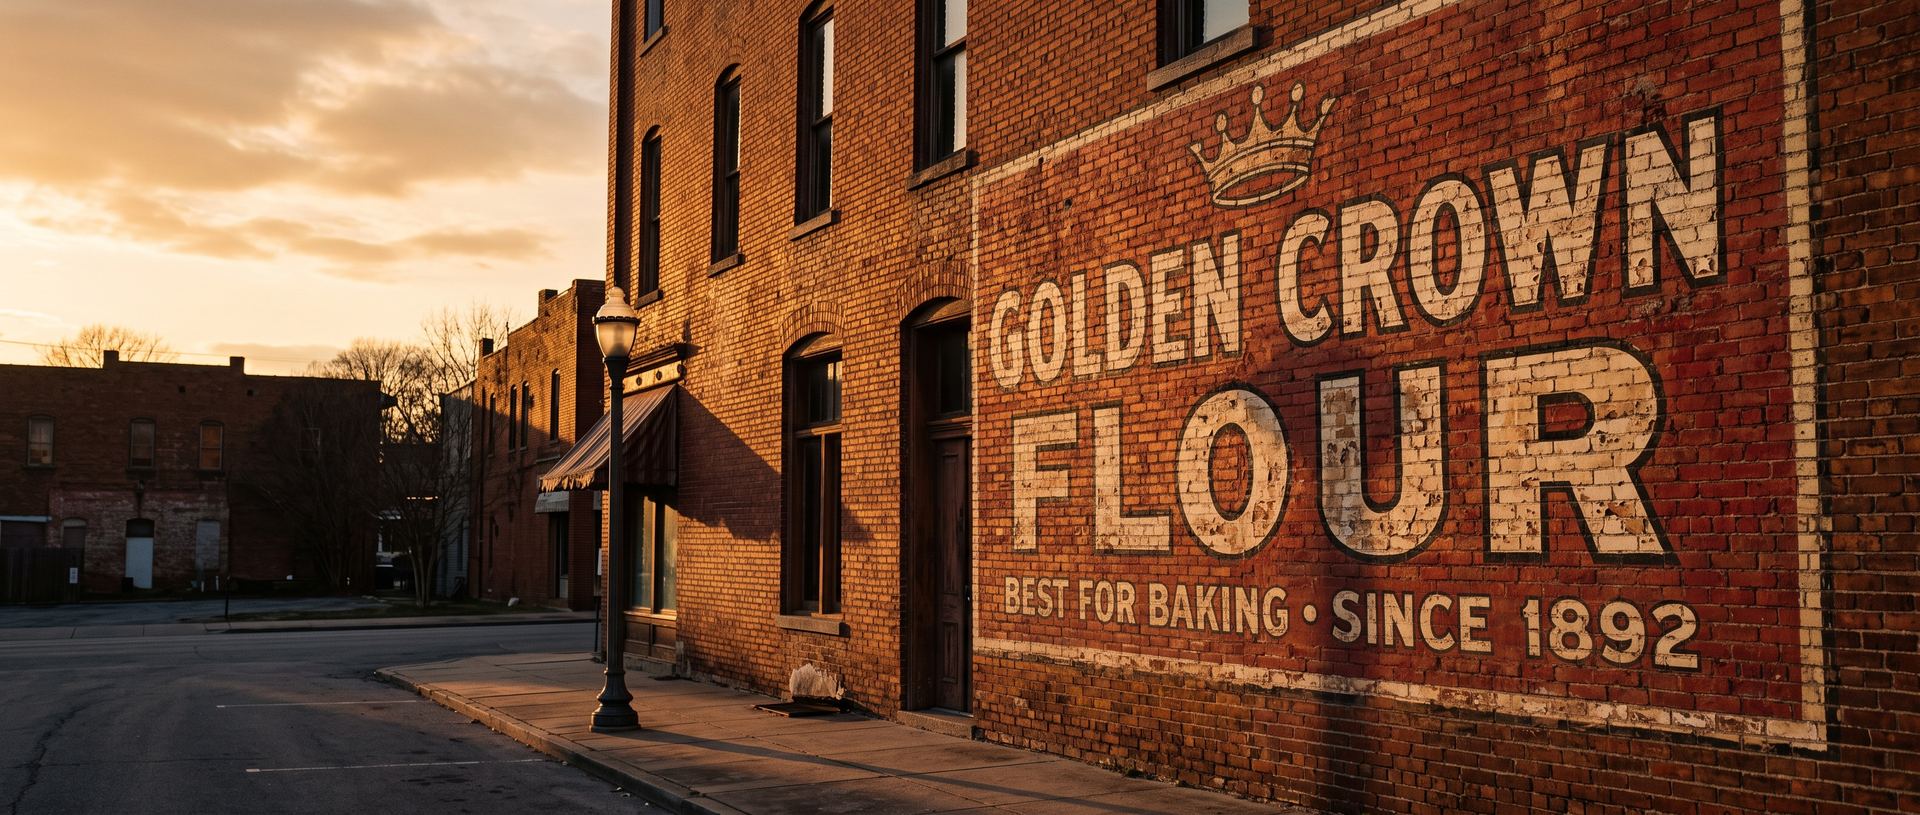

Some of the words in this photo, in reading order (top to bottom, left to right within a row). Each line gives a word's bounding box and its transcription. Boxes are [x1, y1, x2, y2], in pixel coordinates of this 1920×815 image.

[989, 231, 1242, 390] GOLDEN
[1276, 110, 1723, 344] CROWN
[1011, 341, 1670, 561] FLOUR
[1004, 576, 1069, 618] BEST
[1078, 579, 1137, 625] FOR
[1149, 582, 1289, 637] BAKING
[1331, 589, 1492, 653] SINCE
[1522, 598, 1699, 669] 1892
